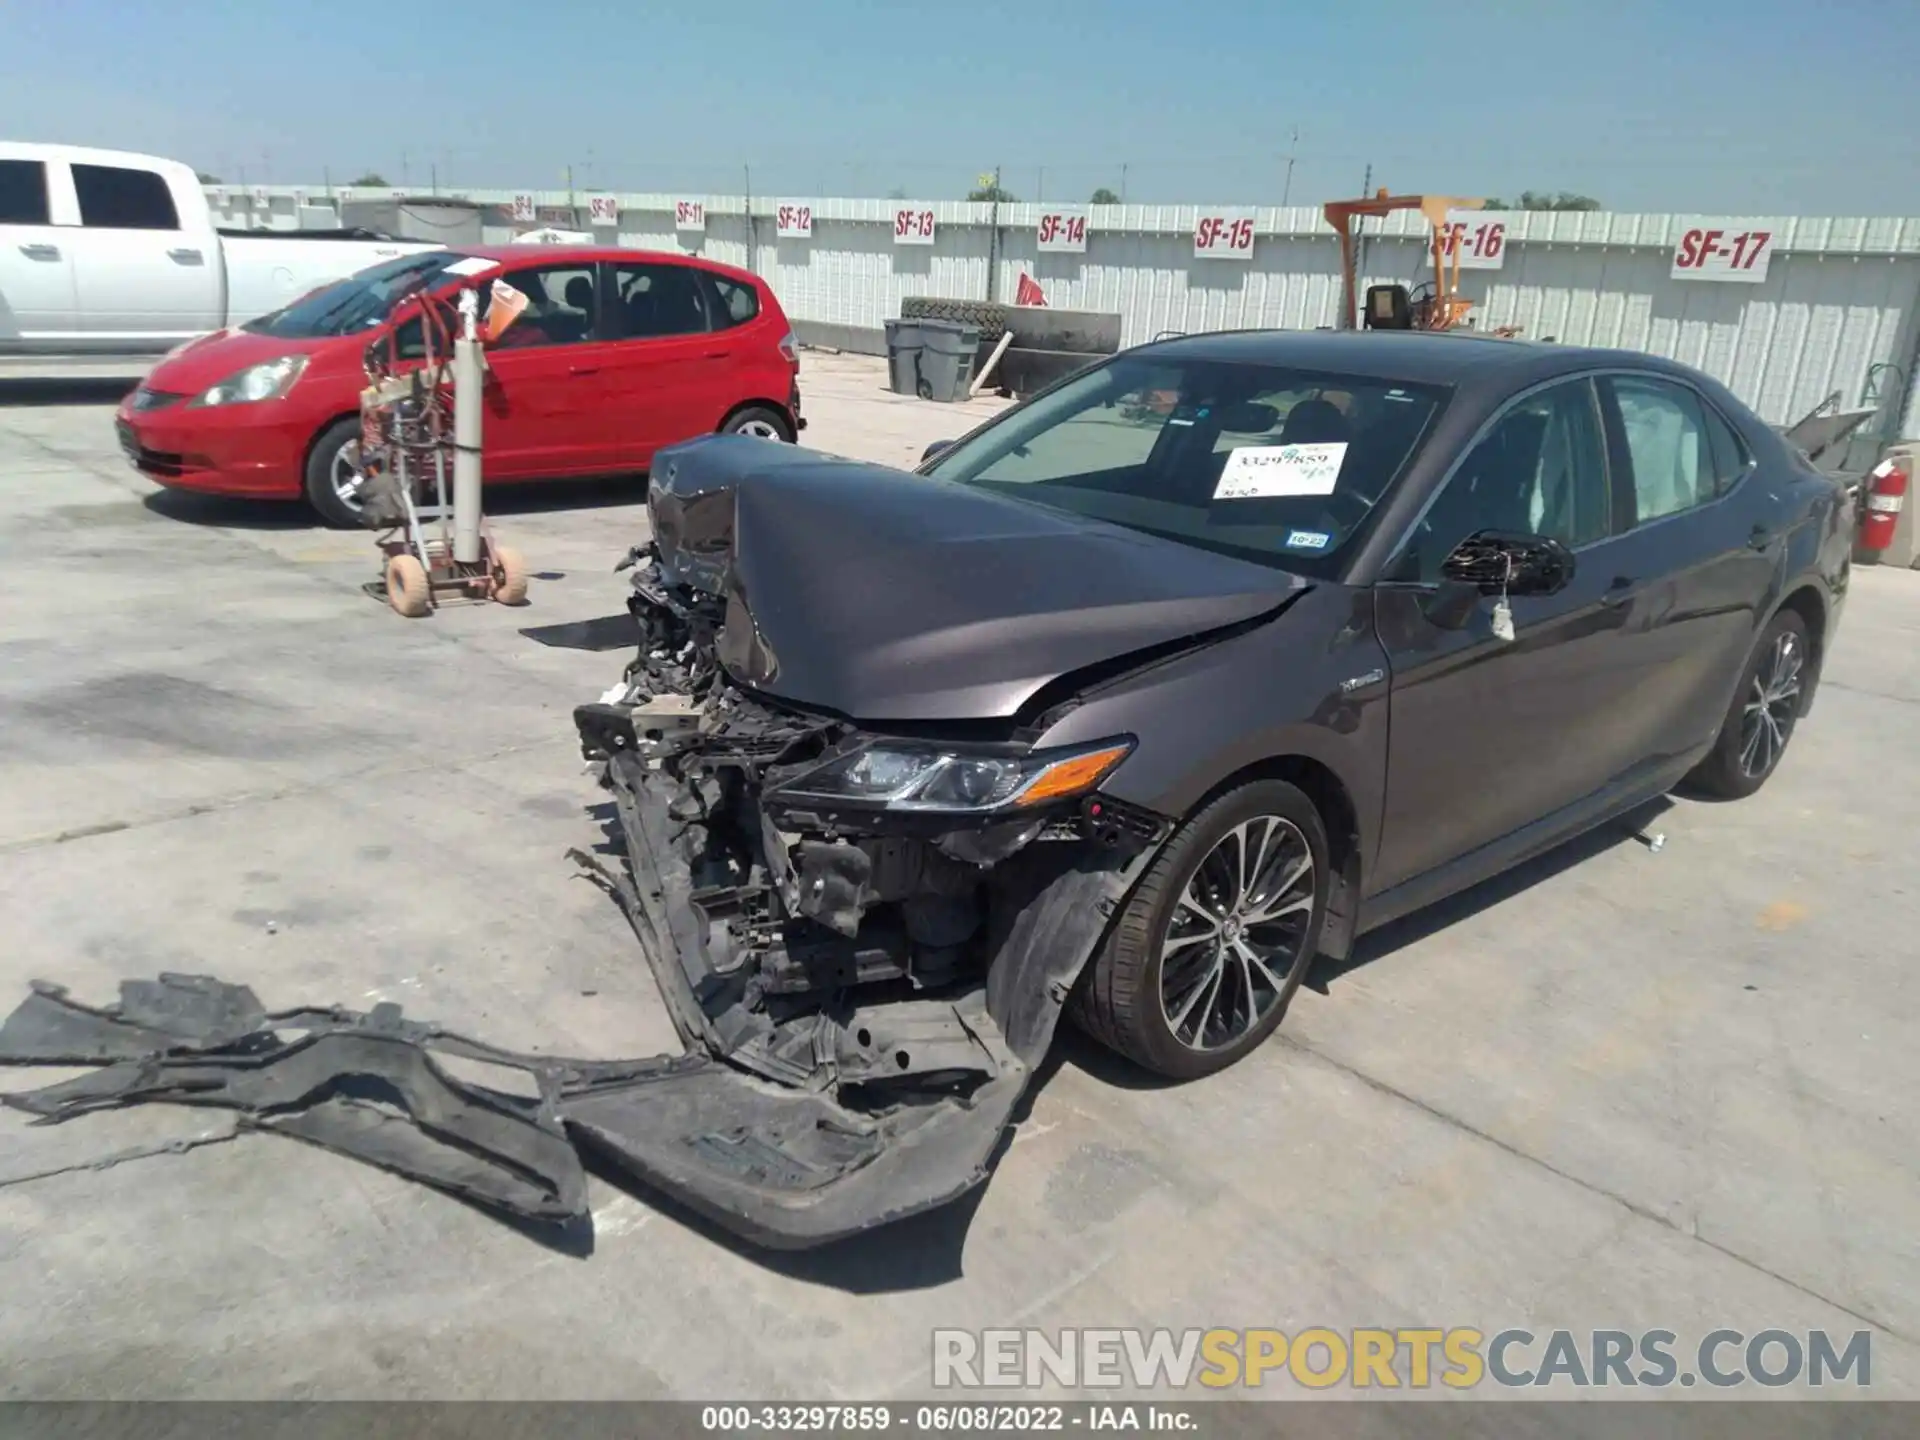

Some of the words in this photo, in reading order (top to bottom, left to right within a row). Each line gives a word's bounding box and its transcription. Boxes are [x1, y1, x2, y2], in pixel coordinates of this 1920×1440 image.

[677, 201, 703, 223] SF-11
[778, 206, 811, 230] SF-12
[896, 210, 934, 237] SF-13
[1039, 214, 1085, 243] SF-14
[1196, 218, 1254, 250] SF-15
[1676, 229, 1771, 269] SF-17
